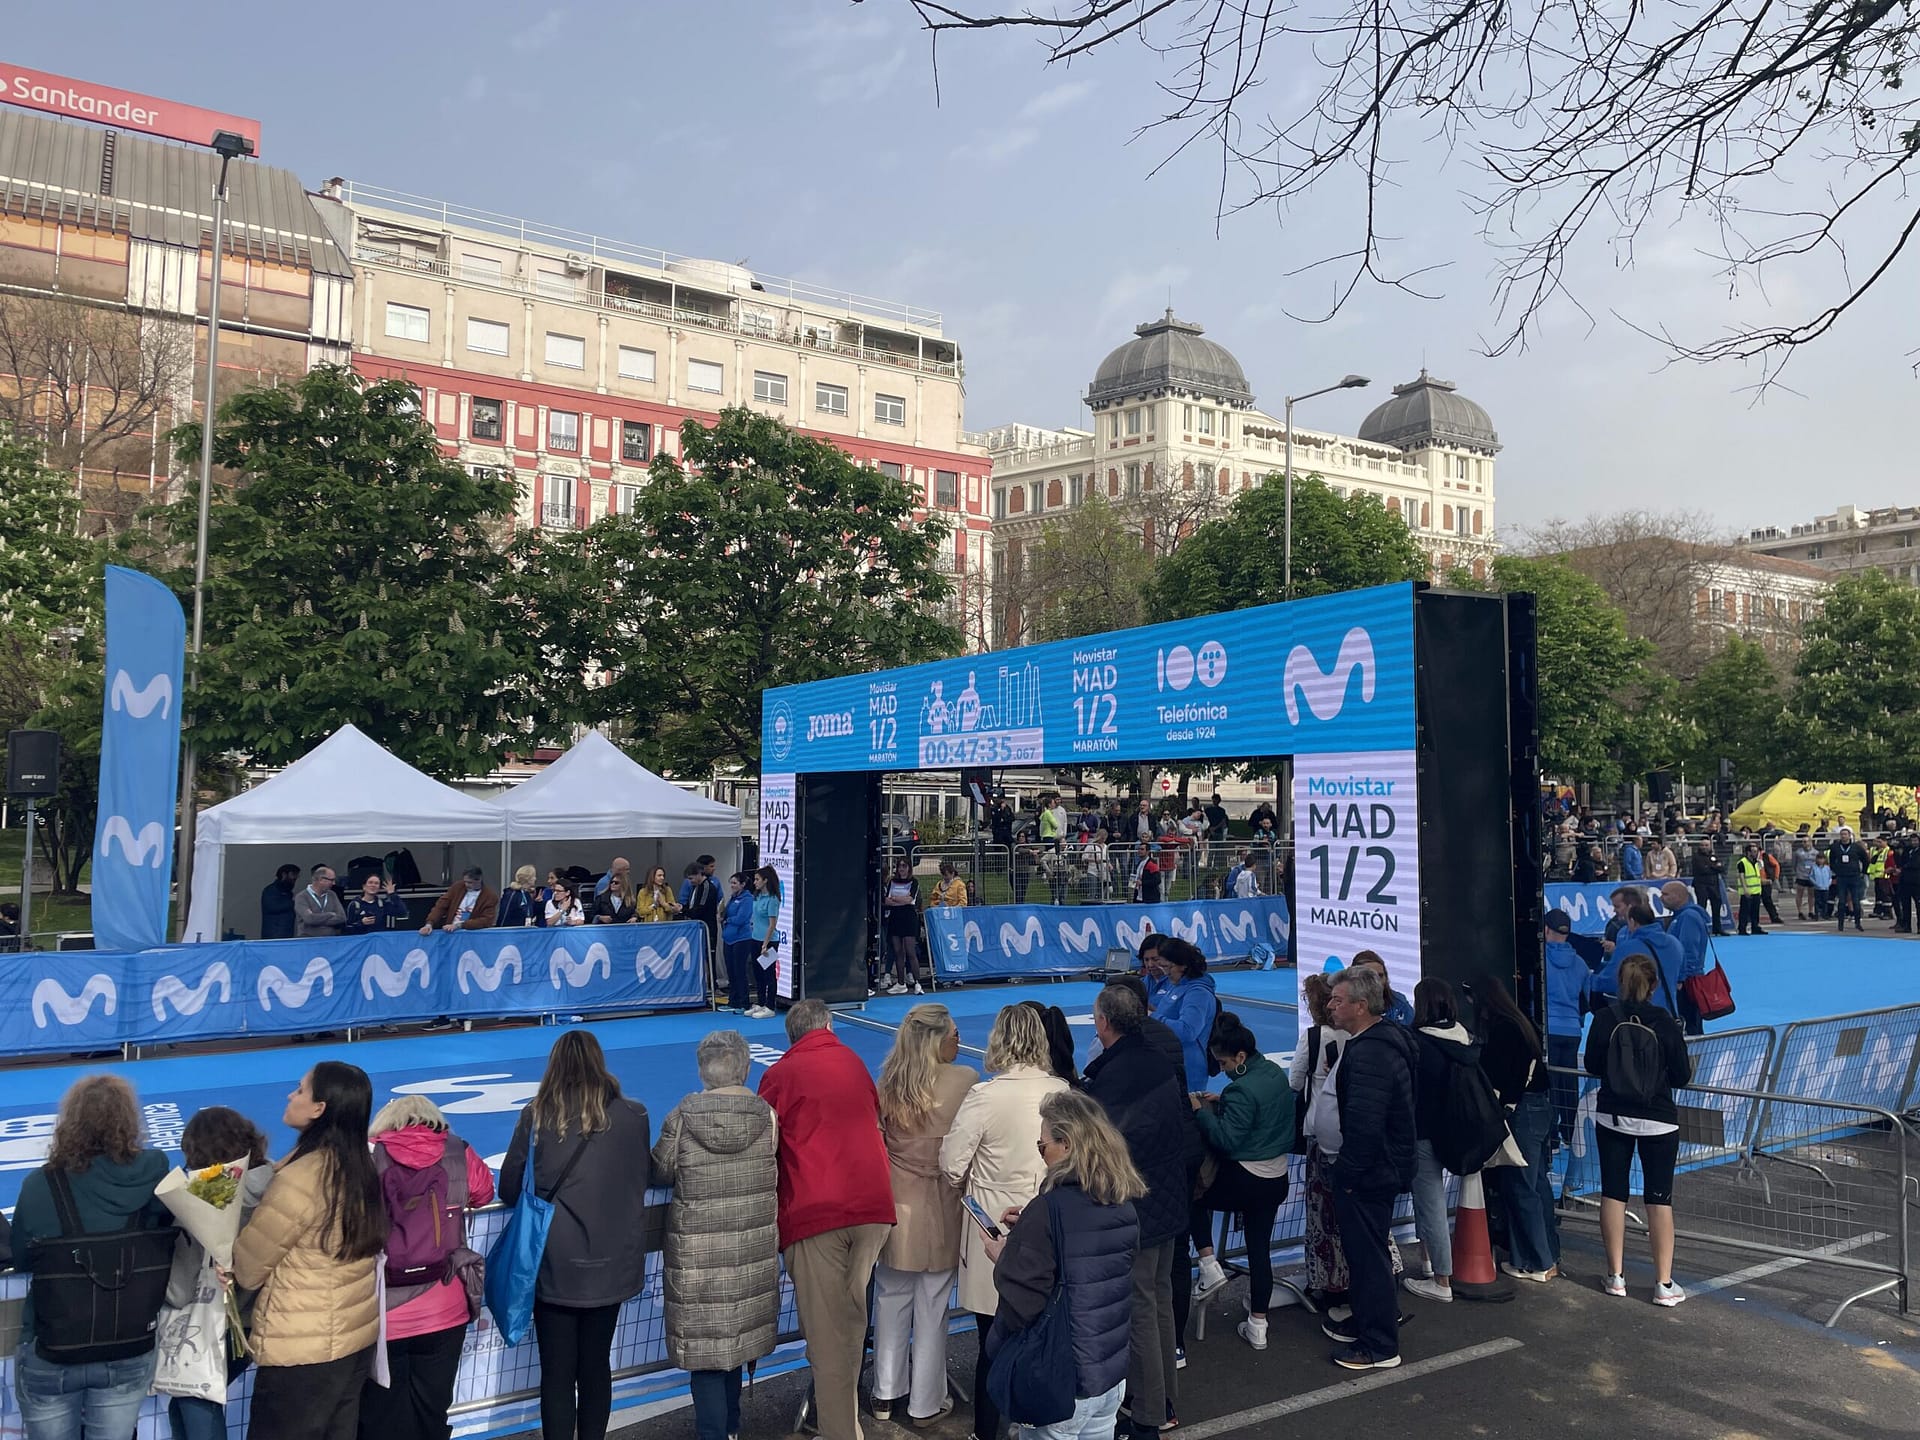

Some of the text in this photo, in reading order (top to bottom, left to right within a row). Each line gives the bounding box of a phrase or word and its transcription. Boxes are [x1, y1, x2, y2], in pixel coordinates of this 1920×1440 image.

[13, 76, 158, 126] Santander
[1073, 648, 1117, 665] Movistar
[869, 681, 897, 695] Movistar
[1073, 665, 1117, 693] MAD
[869, 694, 897, 716] MAD
[1073, 693, 1118, 735] 1/2
[1157, 702, 1227, 724] Telefónica
[869, 717, 897, 750] 1/2
[1073, 736, 1118, 752] MARATÓN
[1166, 726, 1216, 741] desde 1924
[1308, 775, 1396, 797] Movistar
[765, 800, 790, 820] MAD
[1309, 803, 1396, 839] MAD
[764, 822, 790, 854] 1/2
[1310, 844, 1398, 905] 1/2
[1310, 906, 1398, 932] MARATÓN
